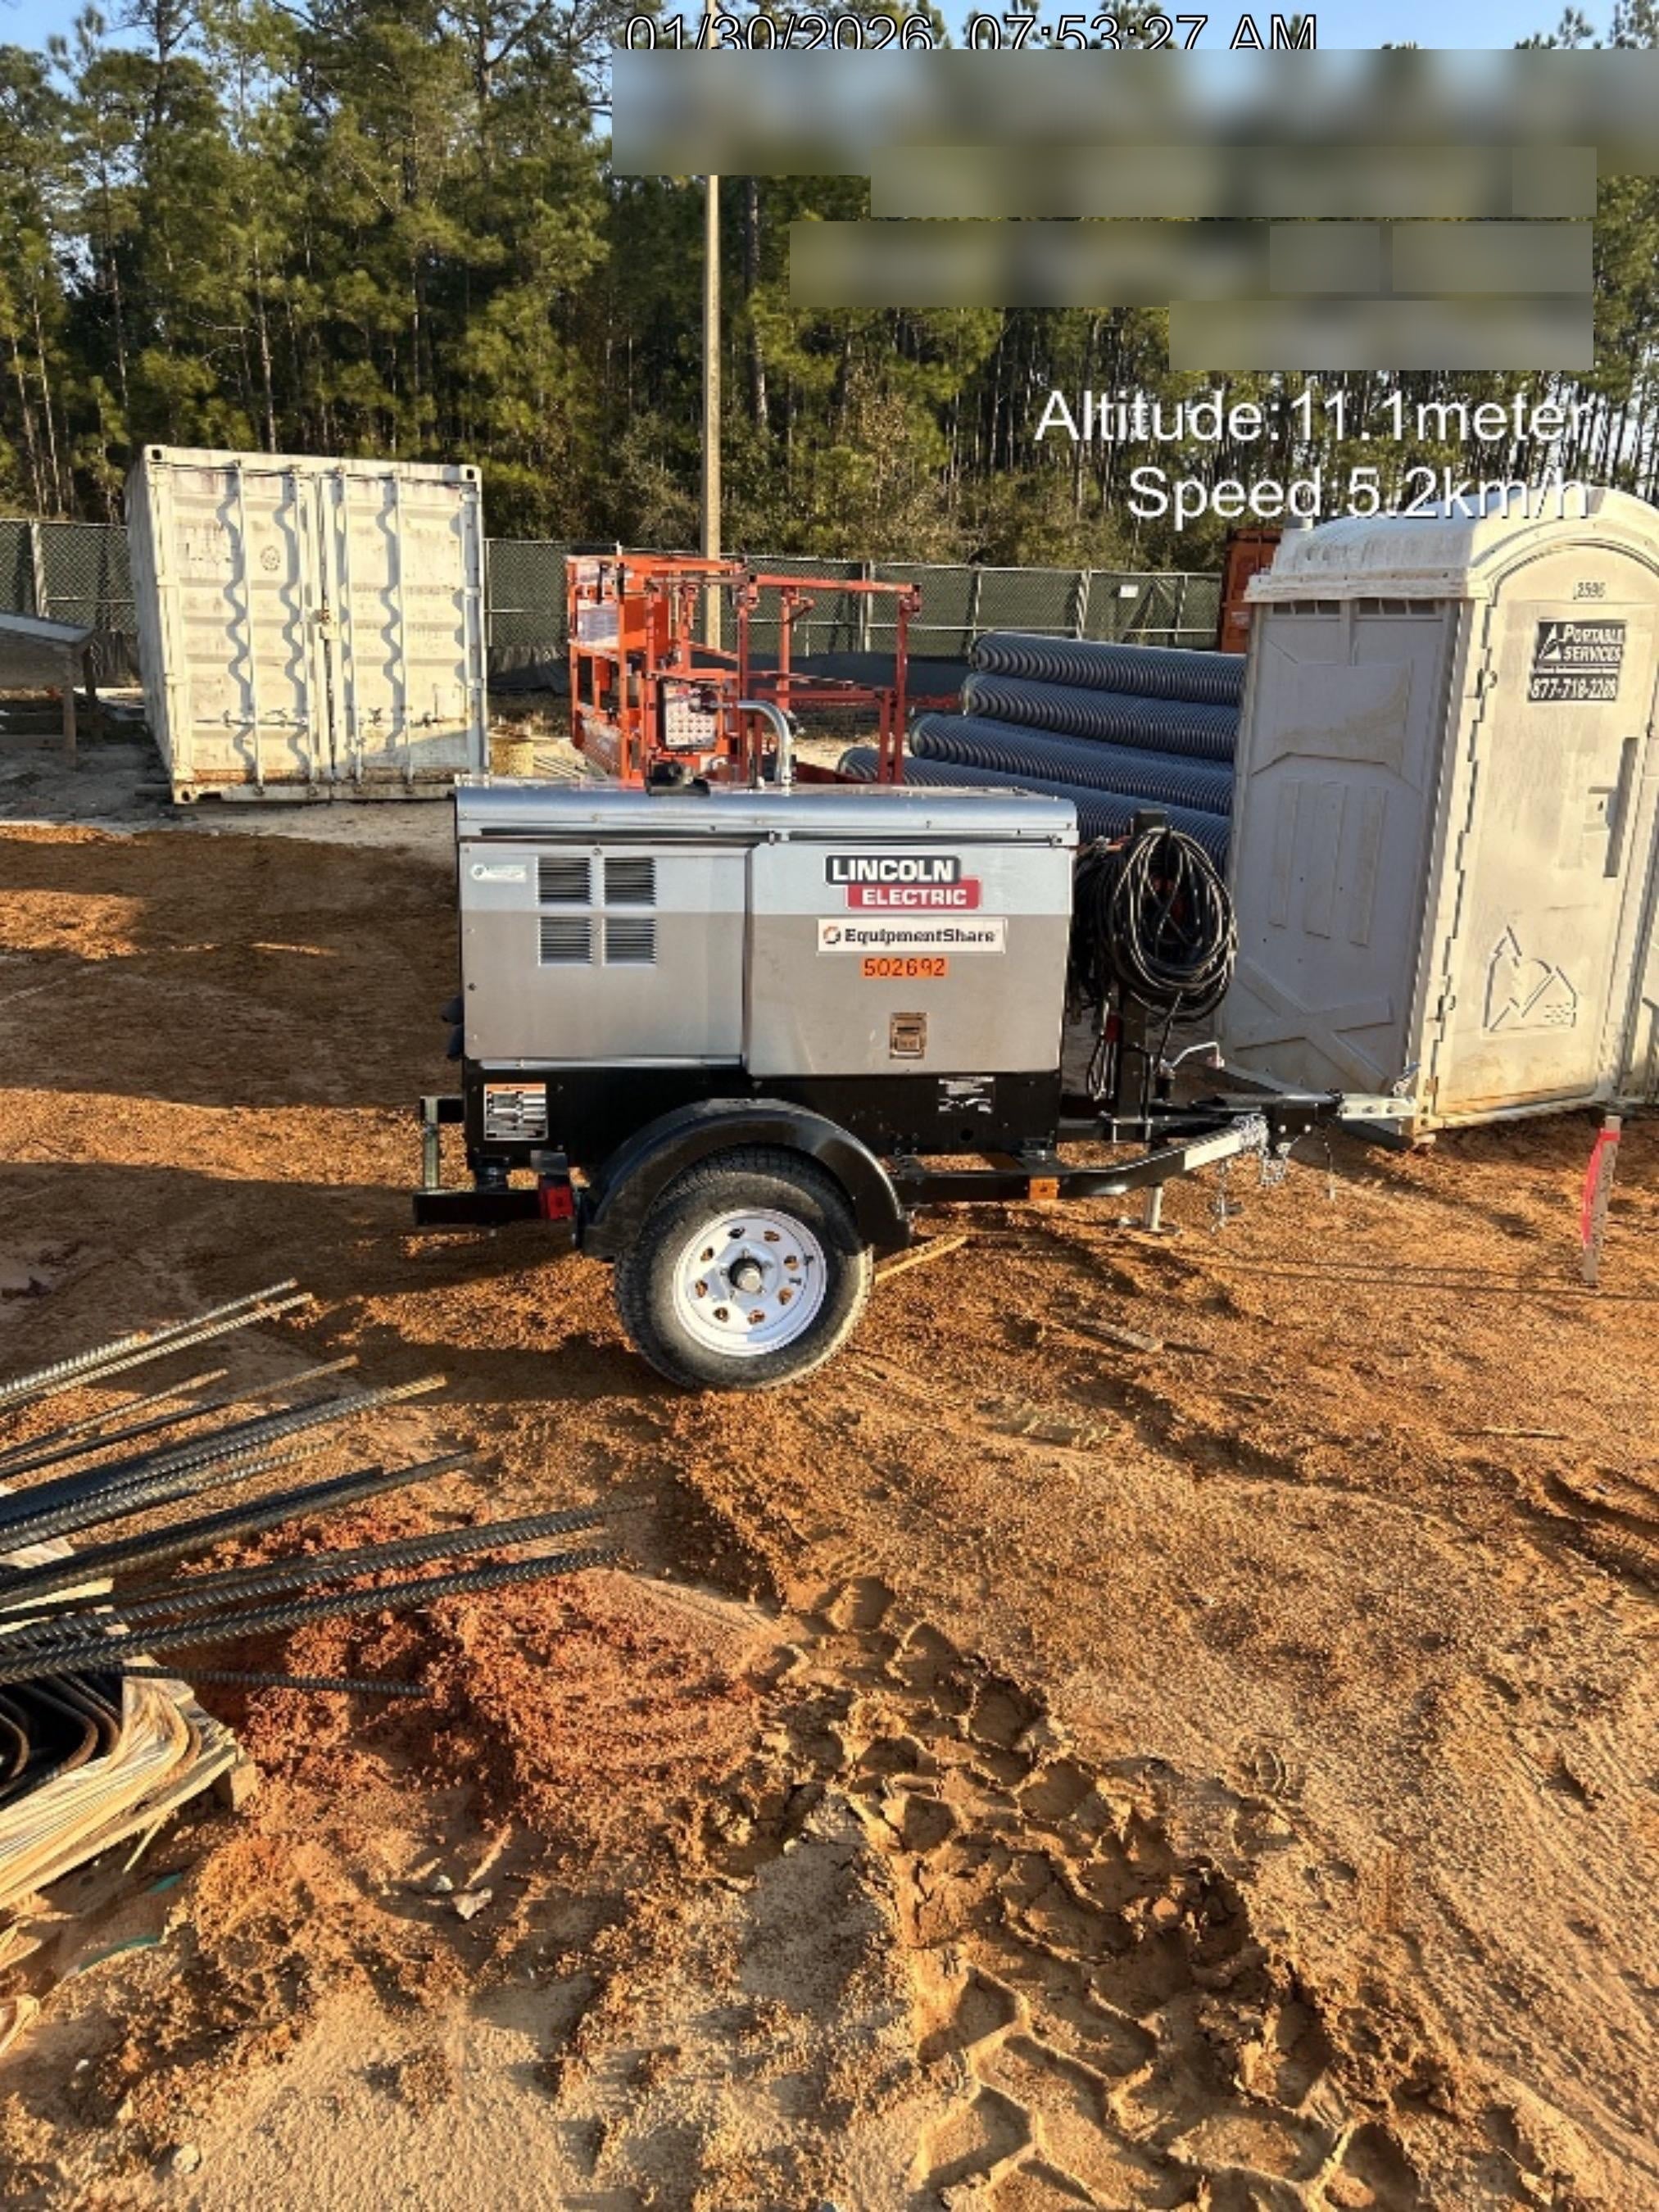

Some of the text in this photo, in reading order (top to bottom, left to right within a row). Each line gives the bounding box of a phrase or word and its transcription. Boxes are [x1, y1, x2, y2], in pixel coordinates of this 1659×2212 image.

[832, 859, 953, 882] LINCOLN
[862, 889, 967, 905] ELECTRIC
[845, 928, 995, 945] EquipmentShare
[863, 958, 945, 977] 502692
